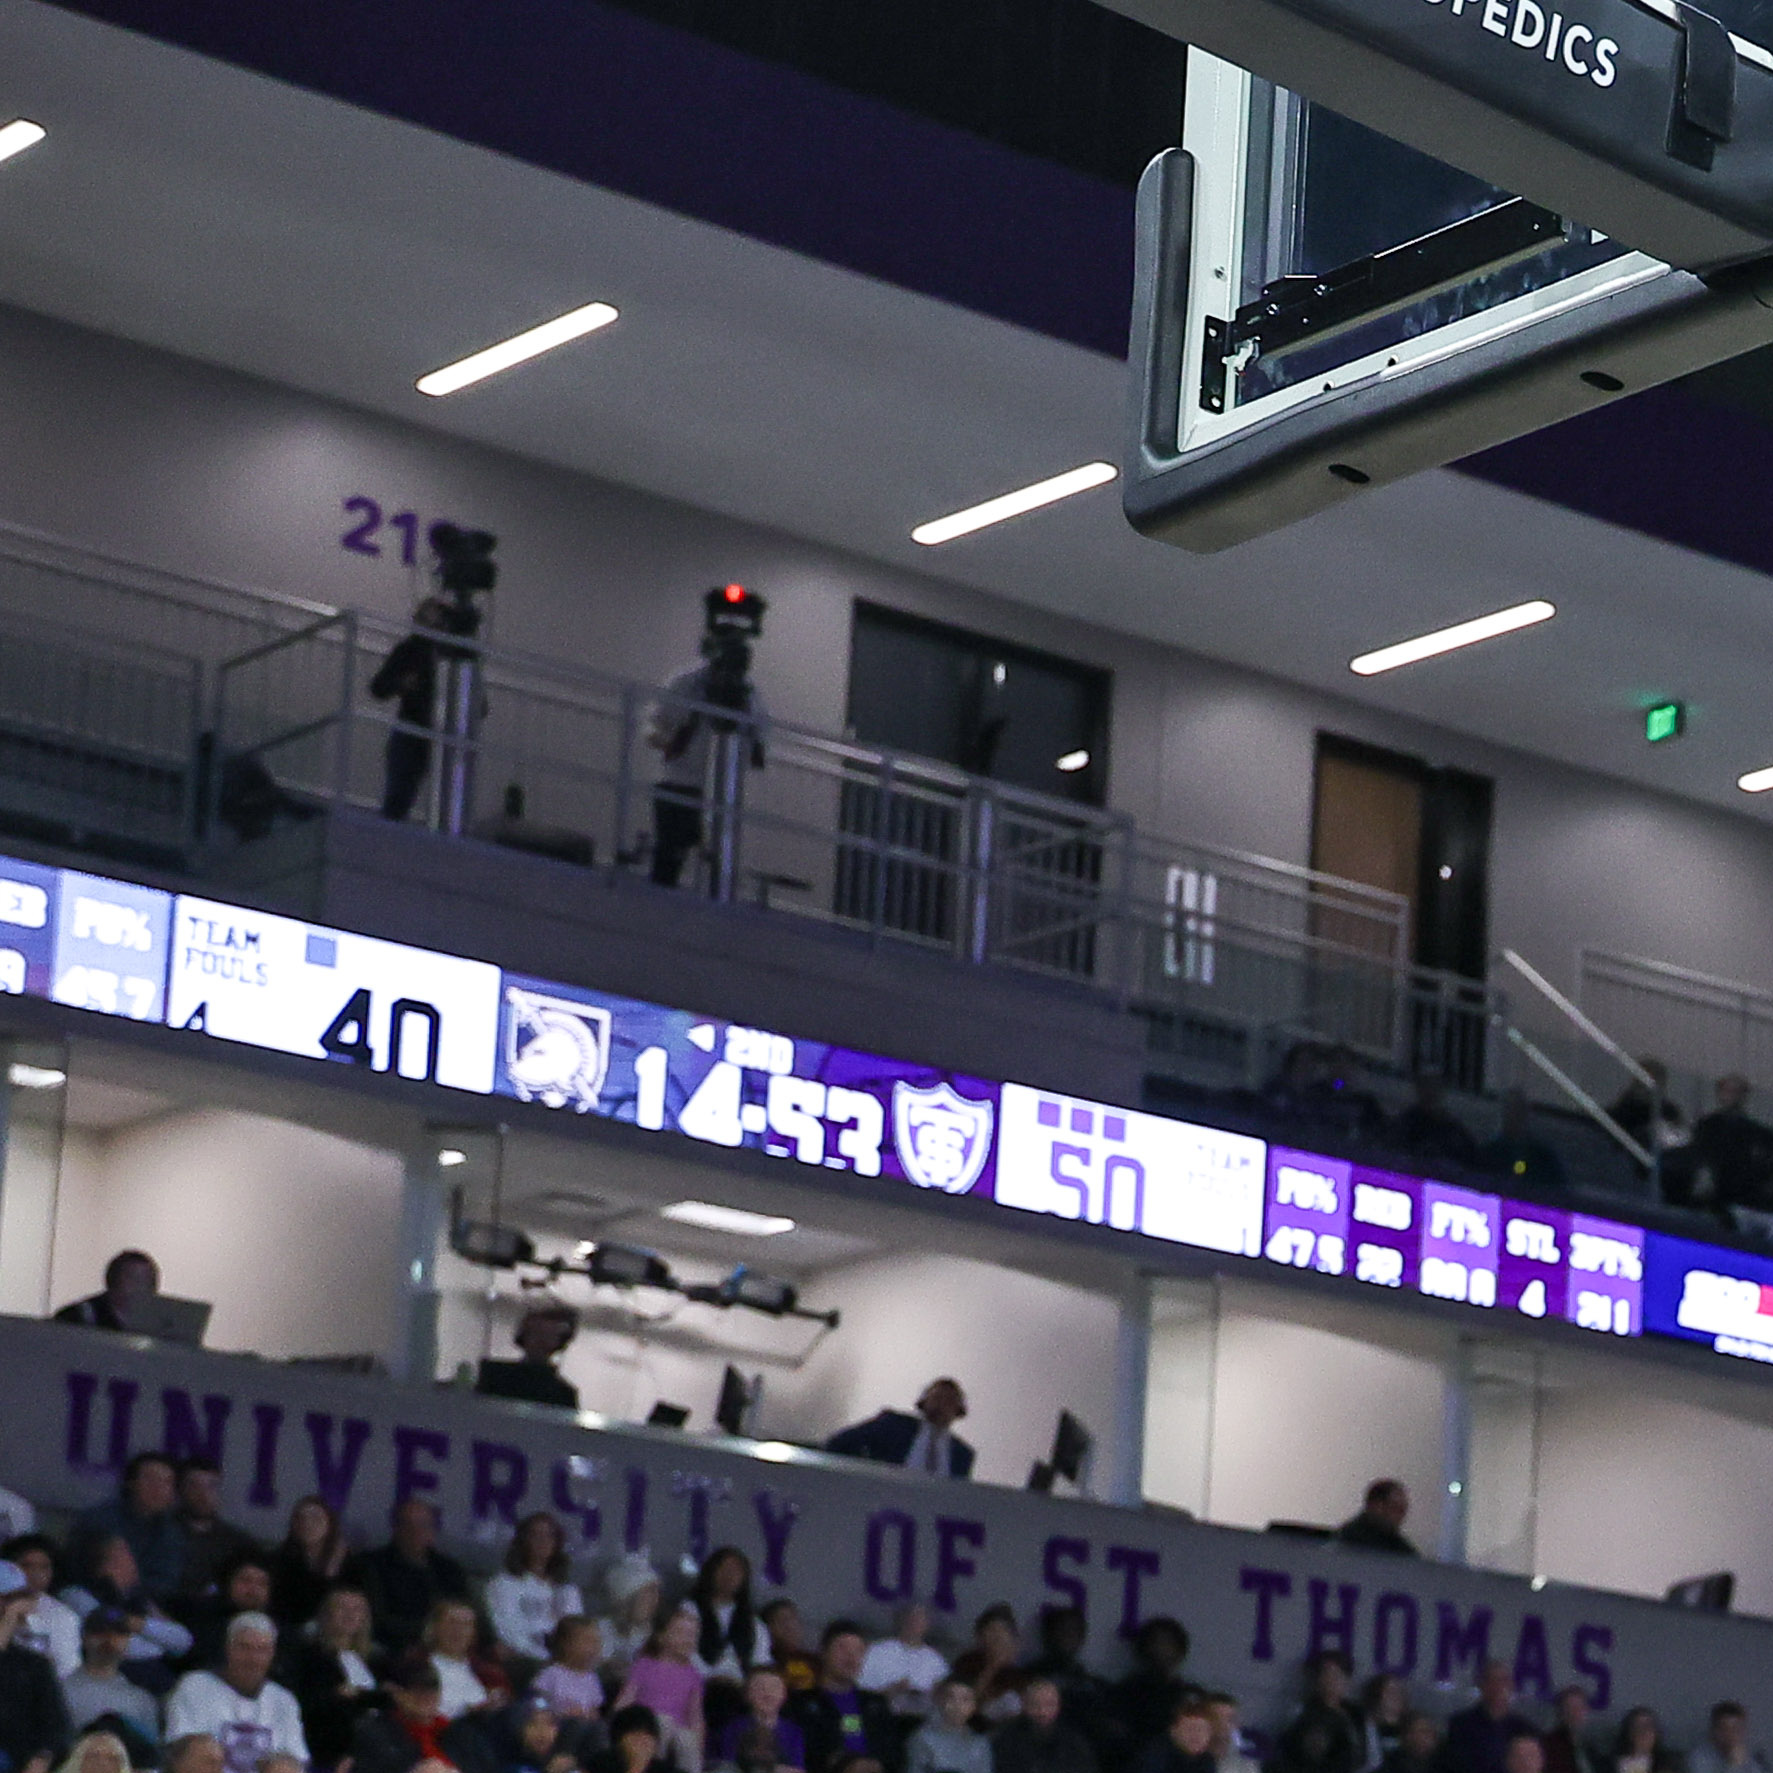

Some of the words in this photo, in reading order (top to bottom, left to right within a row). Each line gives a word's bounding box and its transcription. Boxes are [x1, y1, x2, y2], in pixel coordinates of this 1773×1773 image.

[187, 916, 260, 953] TEAM
[185, 947, 268, 987] FOULS
[65, 1370, 802, 1587] UNIVERSITY
[864, 1507, 986, 1611] OF
[1041, 1535, 1162, 1642] ST
[1240, 1566, 1616, 1711] THOMAS
